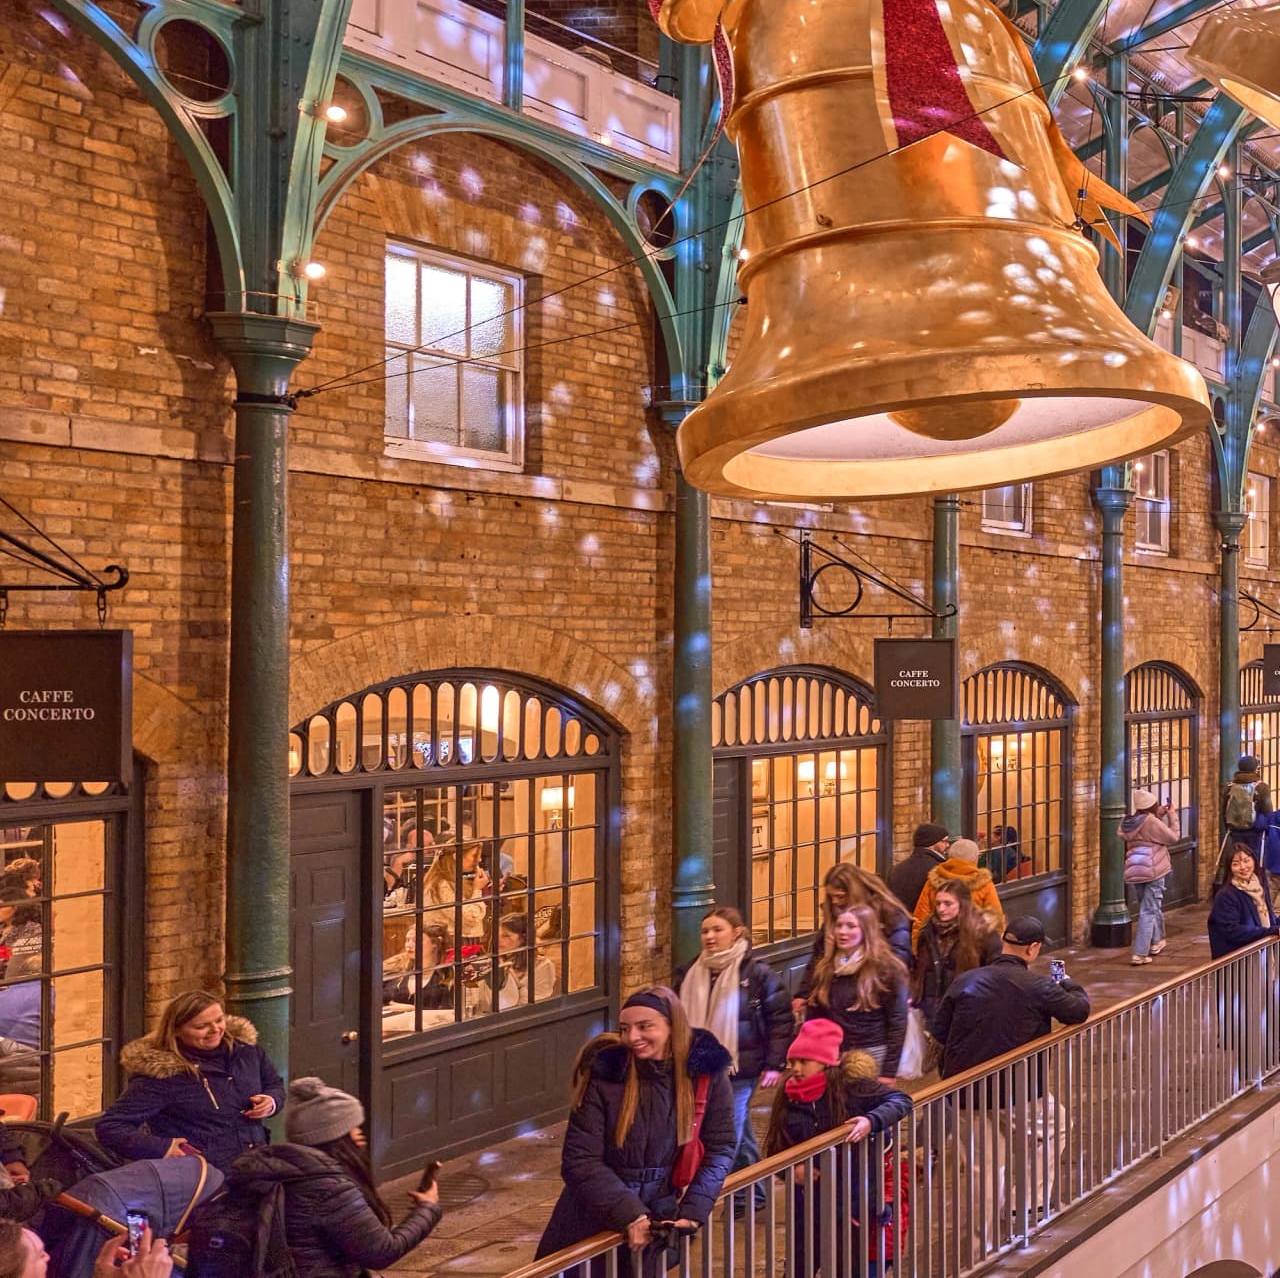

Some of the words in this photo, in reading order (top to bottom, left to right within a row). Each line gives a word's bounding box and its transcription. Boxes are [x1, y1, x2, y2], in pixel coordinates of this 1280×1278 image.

[899, 670, 929, 678] CAFFE
[890, 679, 941, 687] CONCERTO
[20, 690, 74, 703] CAFFE
[3, 708, 95, 721] CONCERTO
